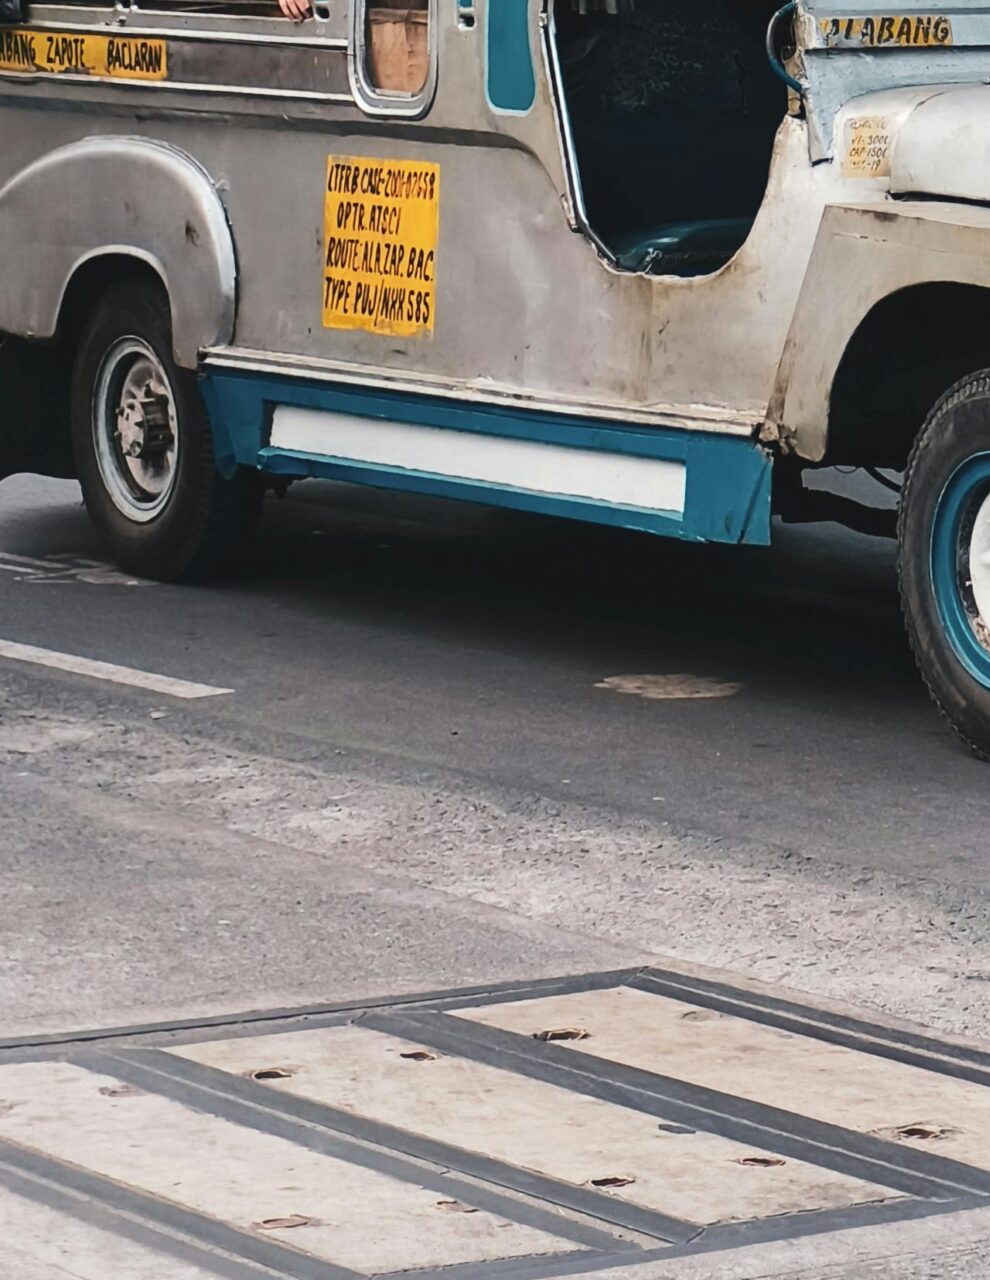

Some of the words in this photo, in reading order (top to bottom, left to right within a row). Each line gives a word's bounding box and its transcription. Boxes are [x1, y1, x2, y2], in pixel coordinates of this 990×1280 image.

[46, 36, 86, 67] ZAPOTE
[107, 39, 162, 73] BACLARAN
[327, 163, 360, 195] LTFRB
[406, 247, 434, 282] BAC.
[324, 276, 352, 314] TYPE
[407, 289, 431, 324] 585
